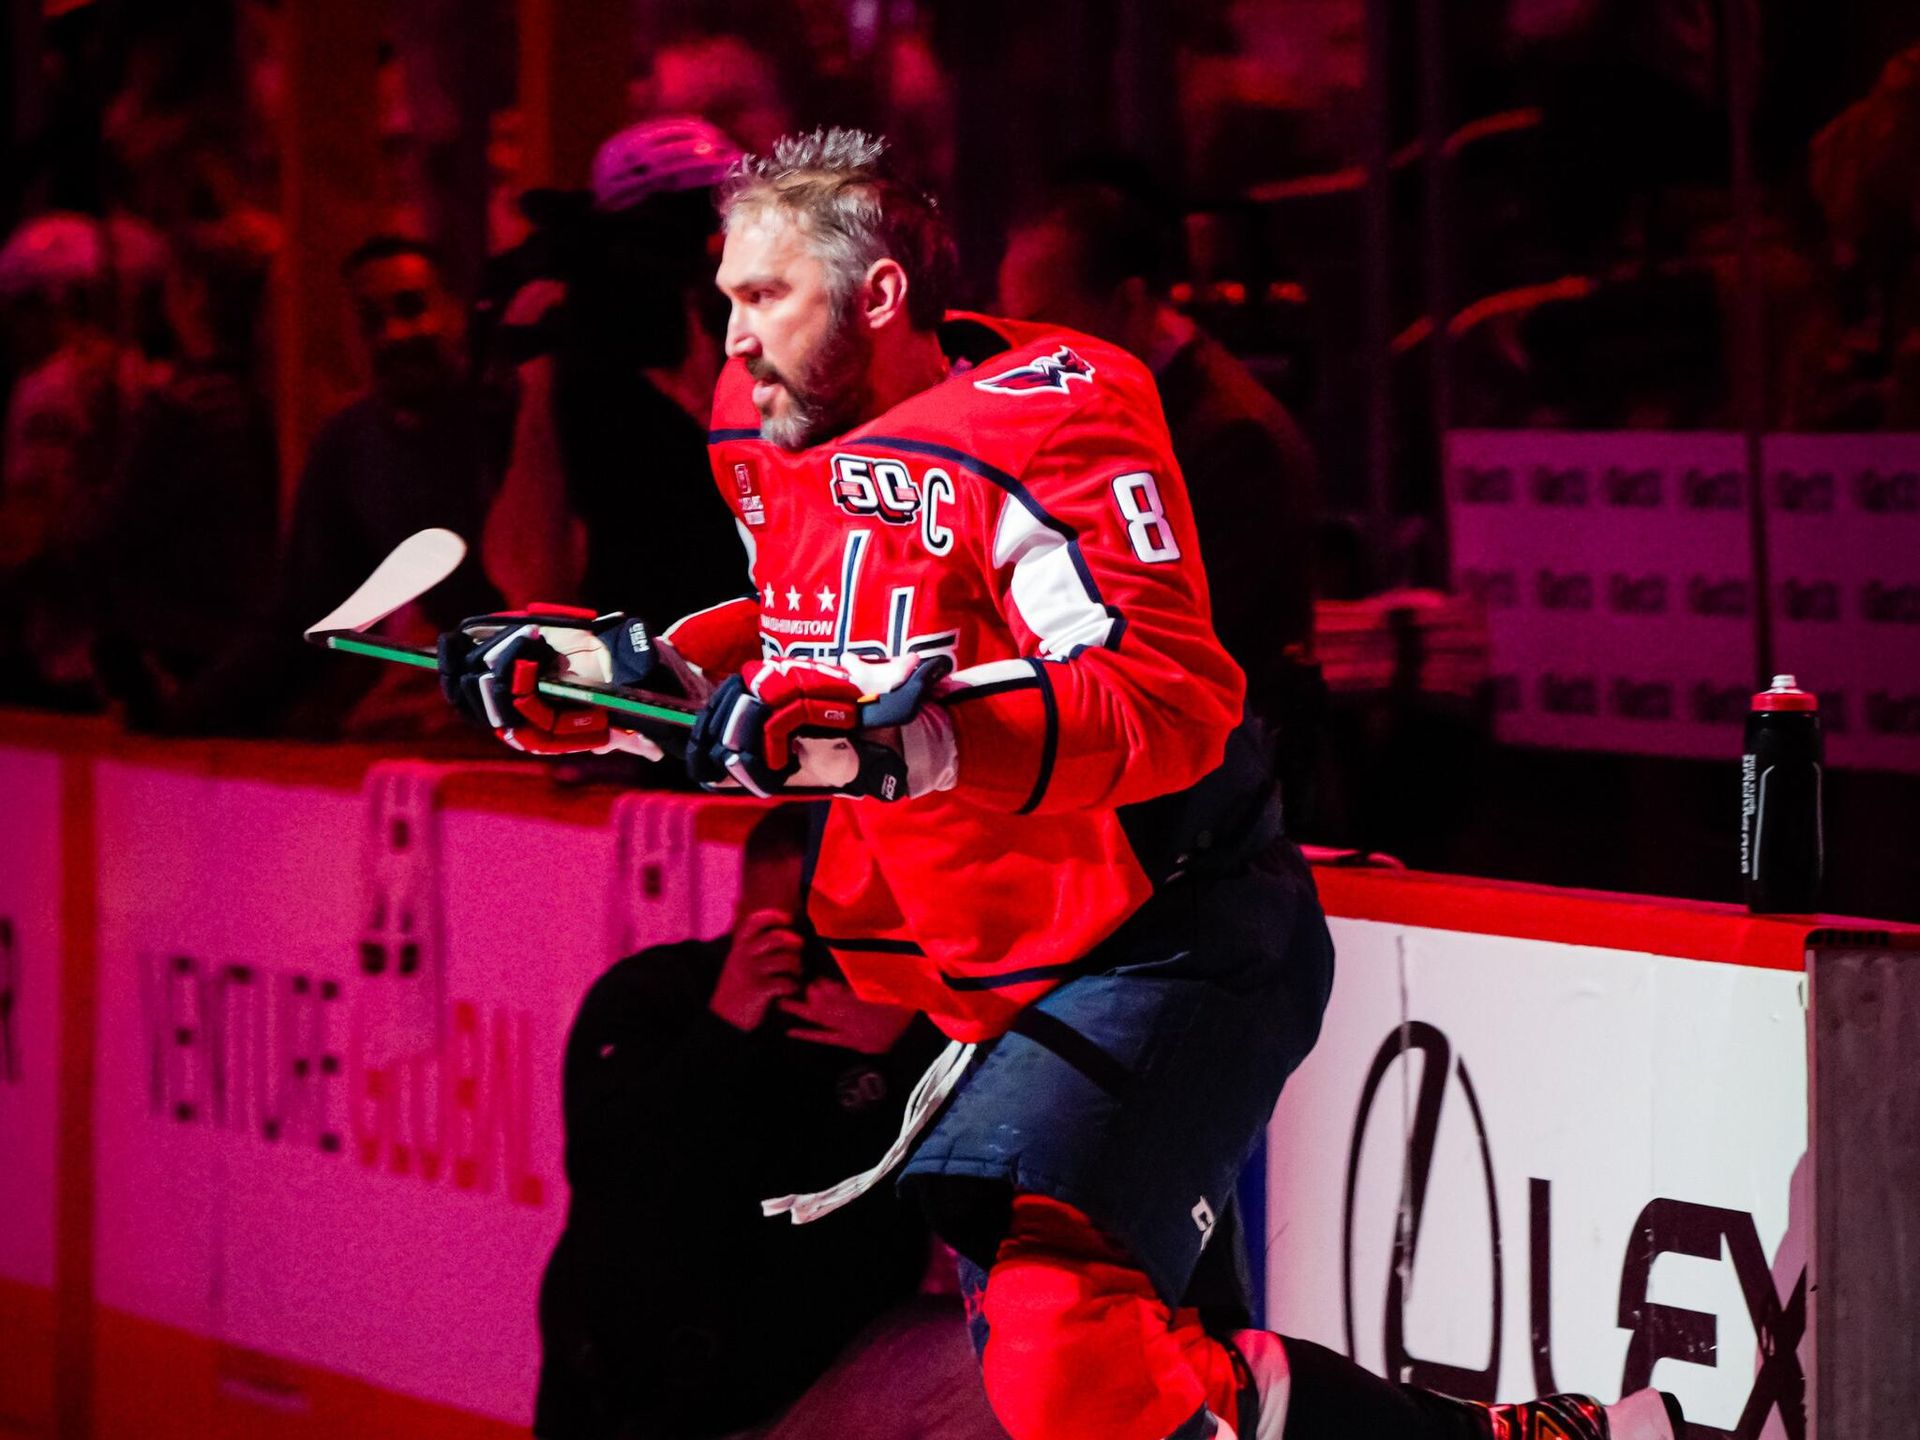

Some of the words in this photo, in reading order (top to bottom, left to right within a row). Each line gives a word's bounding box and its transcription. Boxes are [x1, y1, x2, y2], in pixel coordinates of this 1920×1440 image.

[831, 454, 921, 525] 50
[921, 468, 956, 557] C
[1110, 472, 1181, 564] 8
